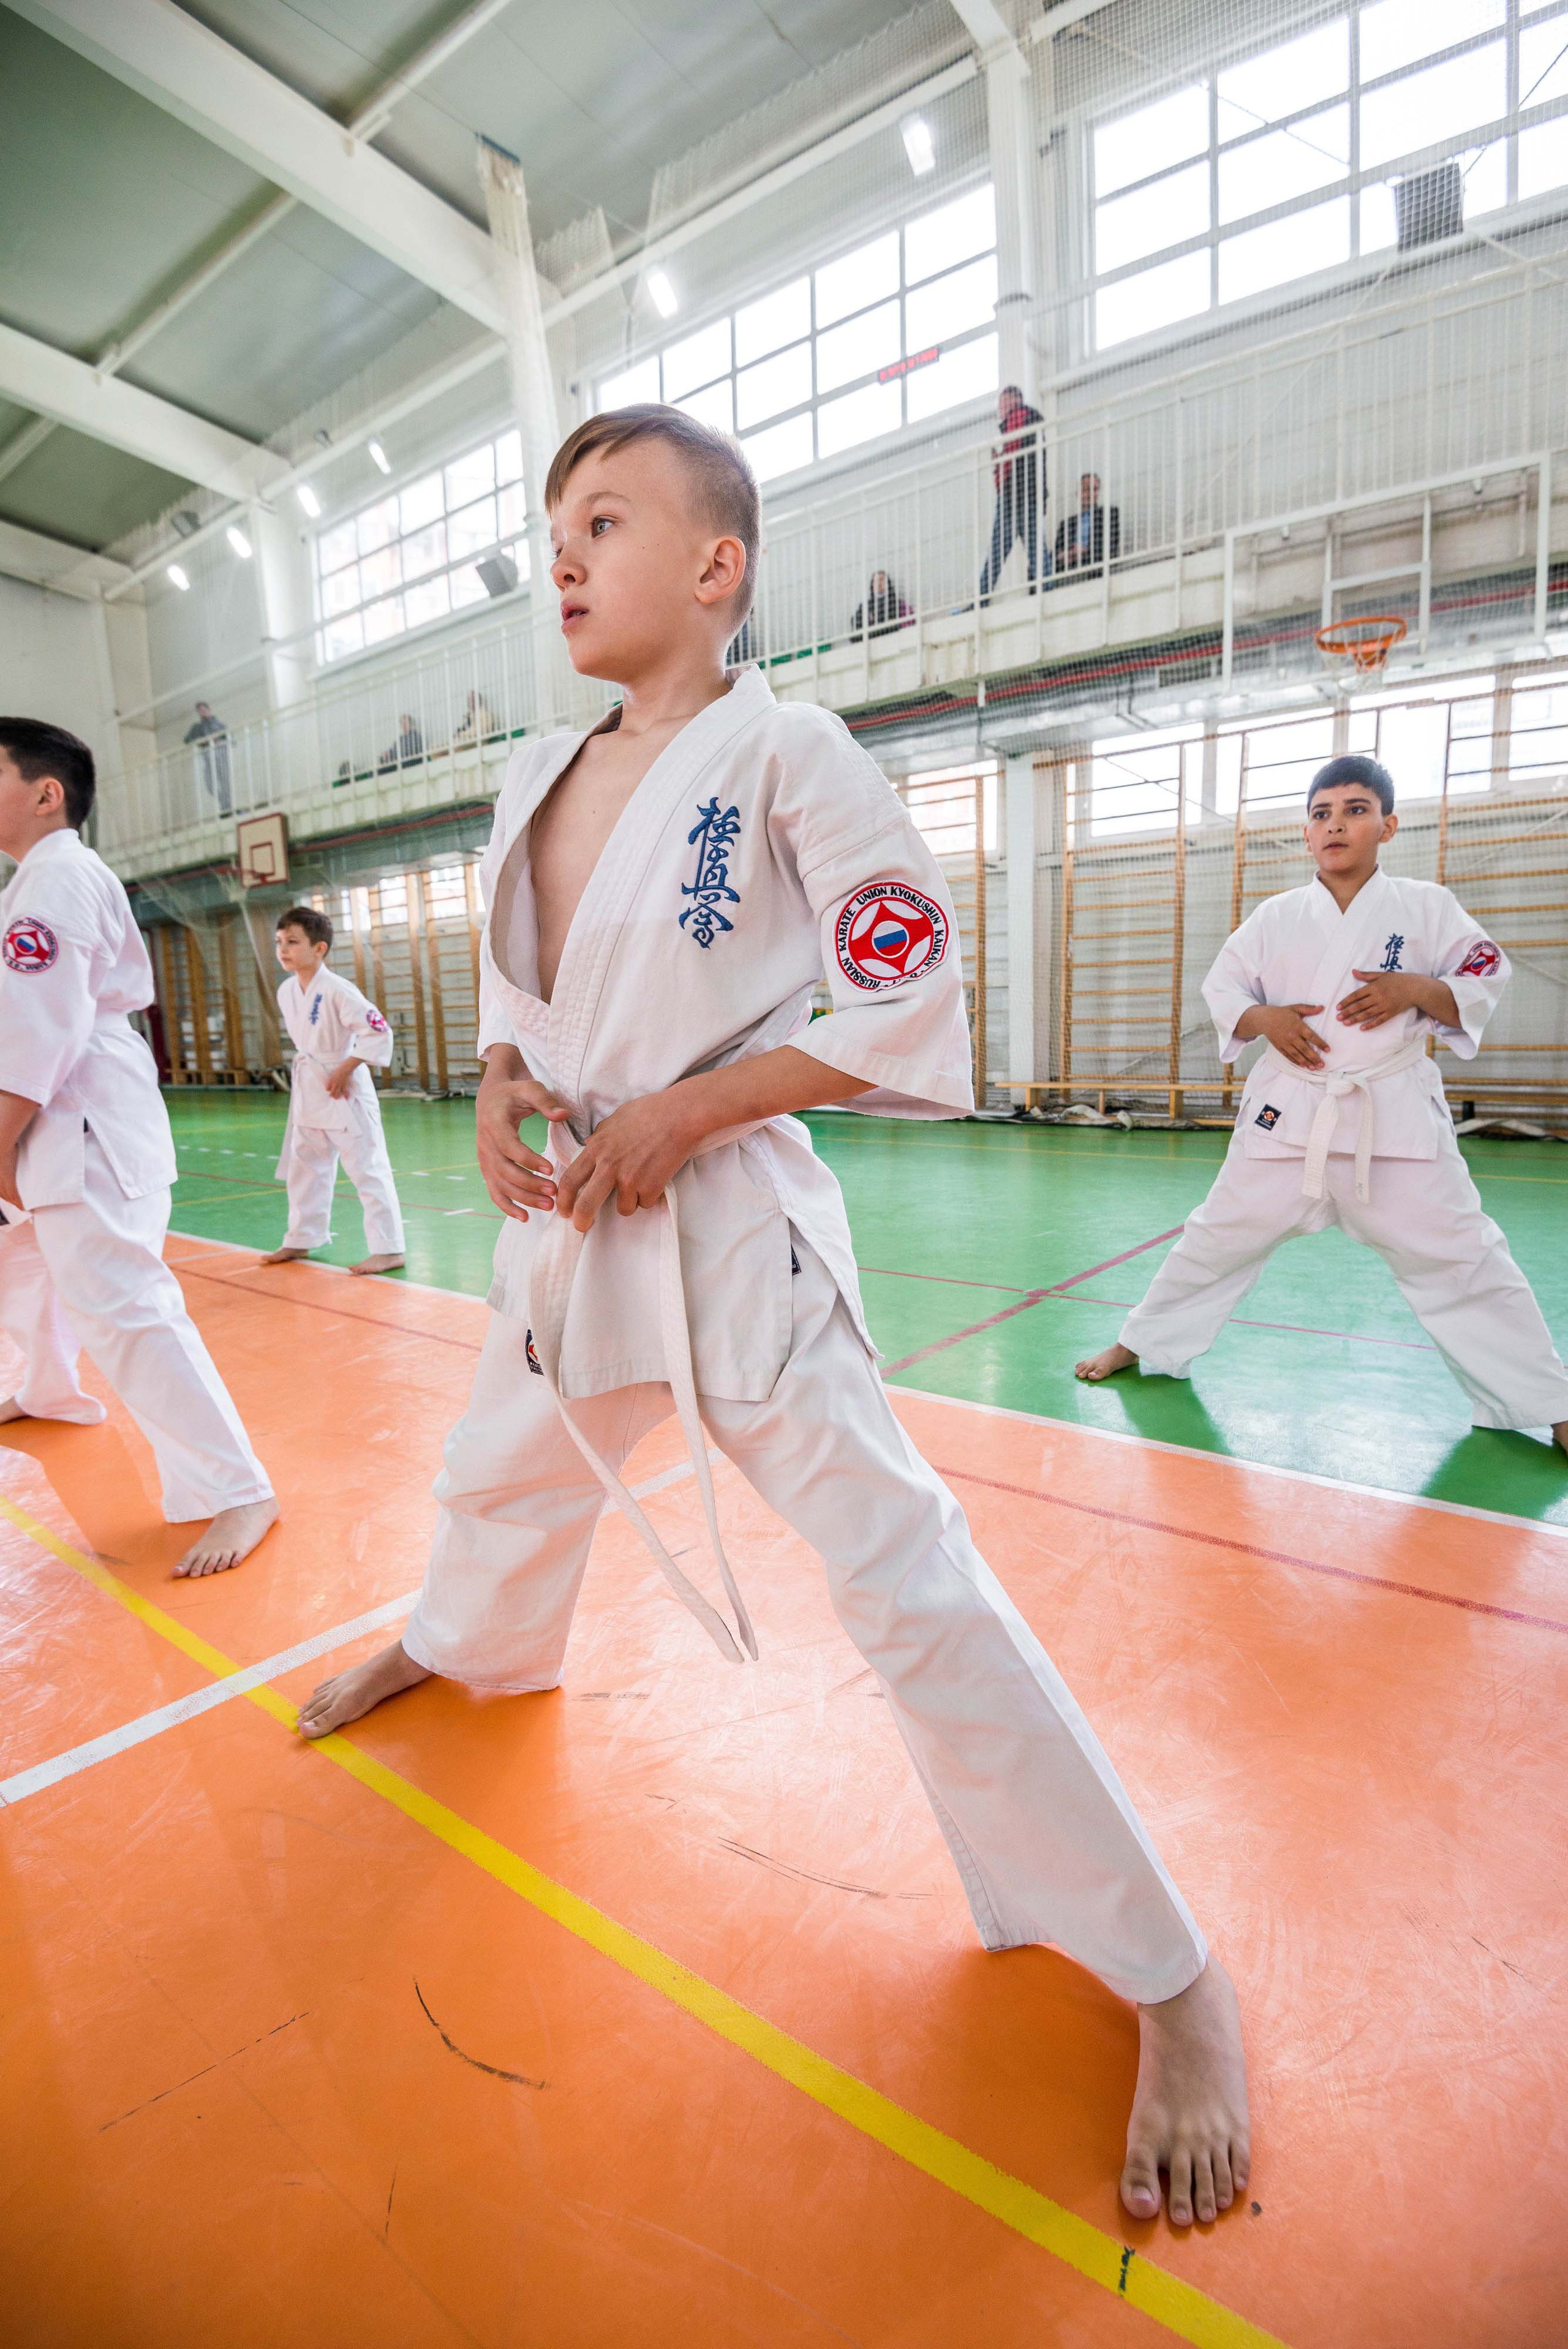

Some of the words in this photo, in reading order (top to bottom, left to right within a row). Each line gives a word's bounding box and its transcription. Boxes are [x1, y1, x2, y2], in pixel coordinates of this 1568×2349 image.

[856, 886, 888, 905] UNION
[890, 886, 942, 925] KYOKUSHIN
[839, 907, 856, 952] KARATE
[924, 929, 944, 967] KAIKAN
[842, 957, 881, 988] RUSSIAN
